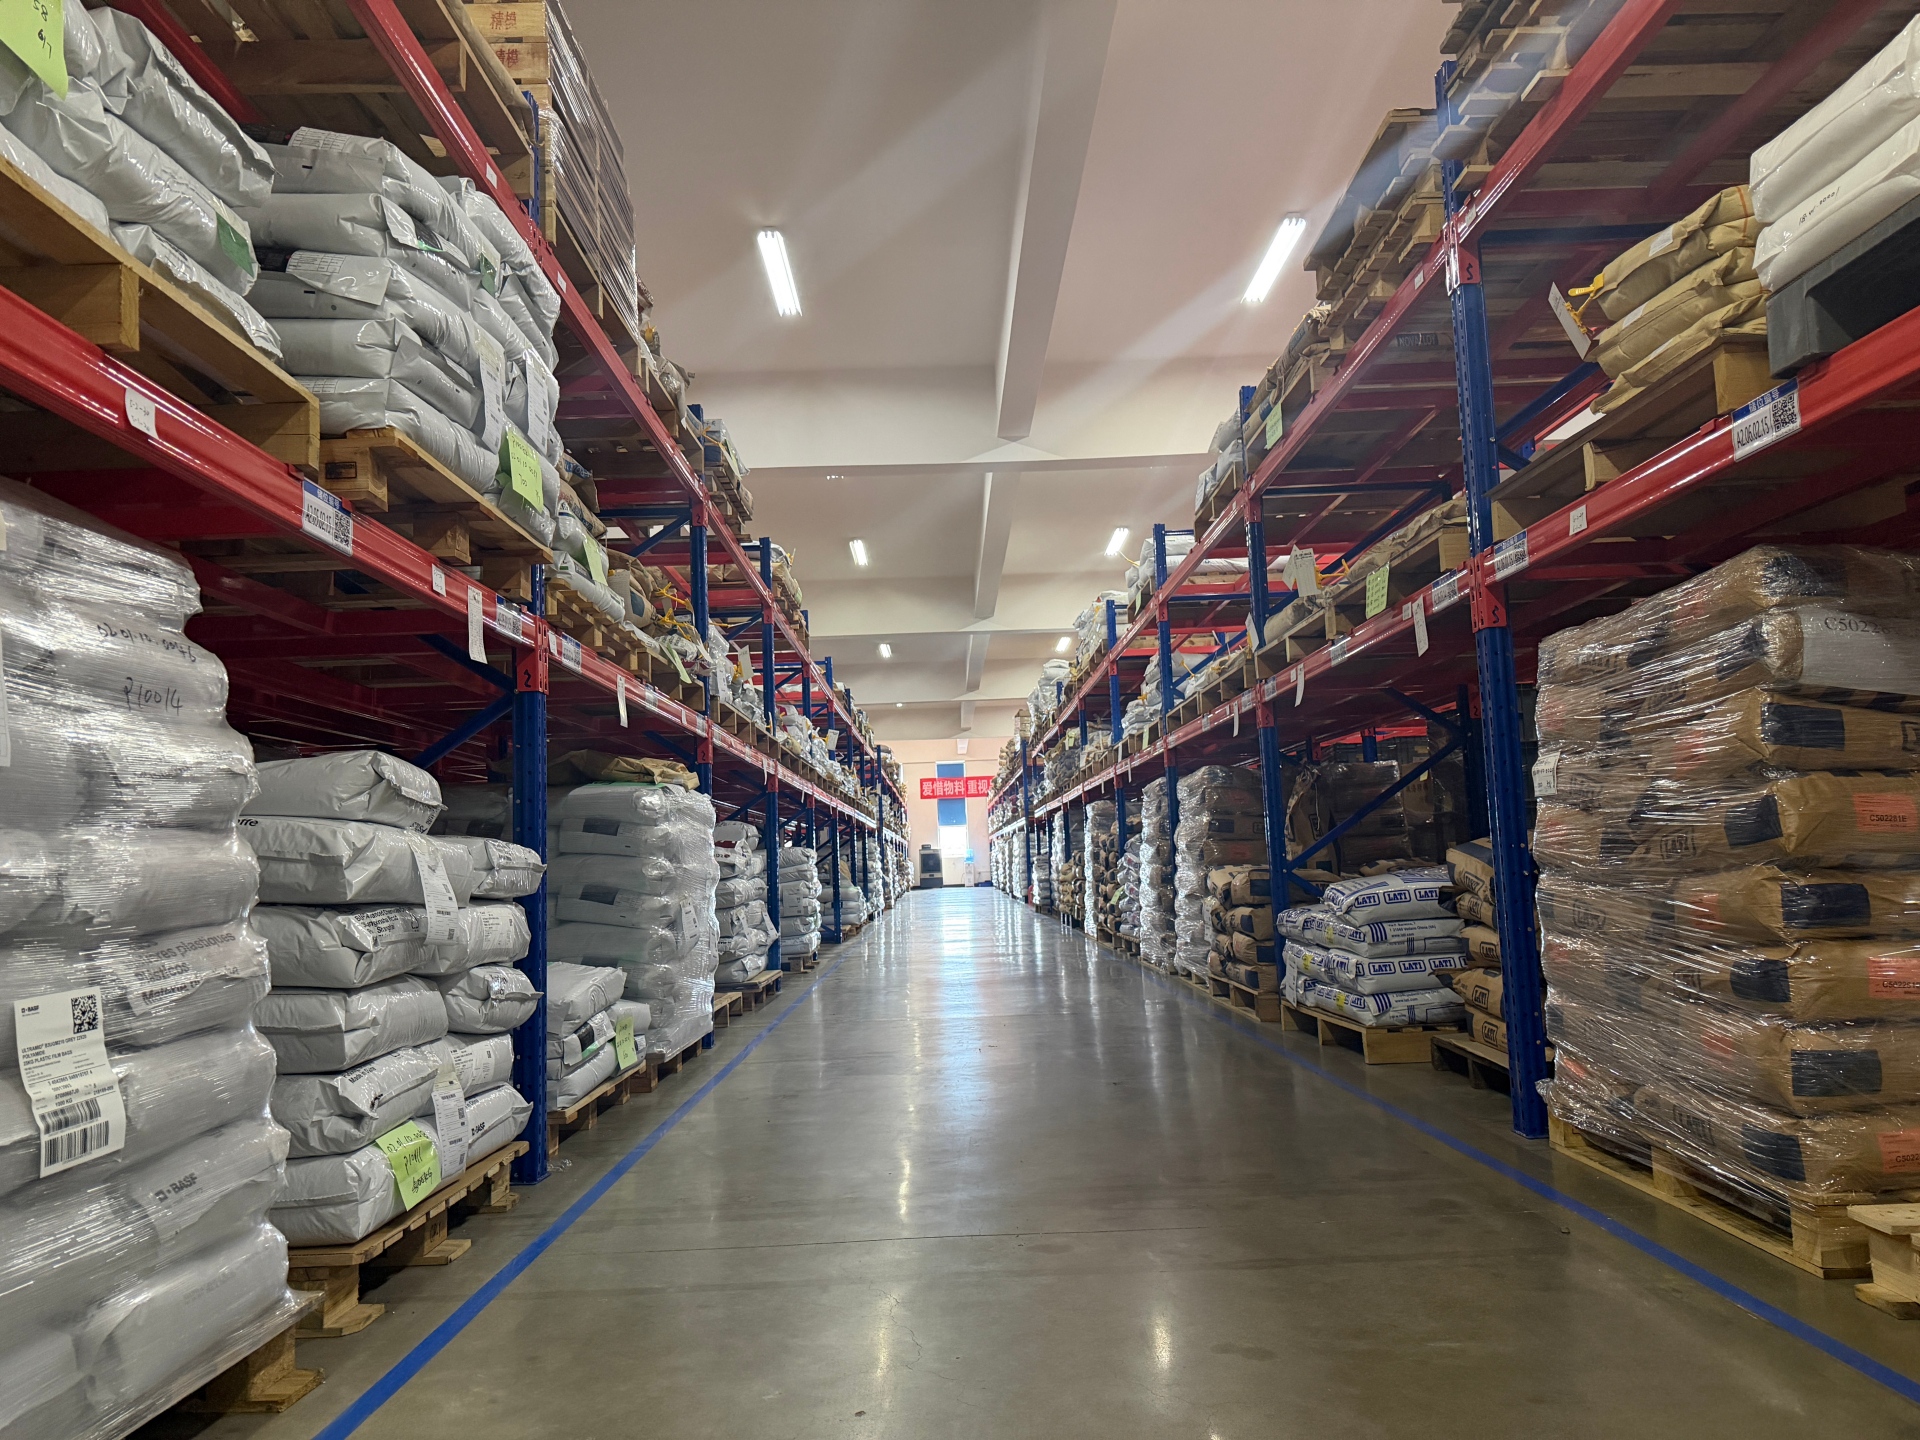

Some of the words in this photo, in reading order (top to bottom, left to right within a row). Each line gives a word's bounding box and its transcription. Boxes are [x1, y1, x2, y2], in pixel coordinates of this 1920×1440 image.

[922, 780, 965, 797] 爱惜物料
[1387, 891, 1408, 902] LATI
[1418, 889, 1439, 900] LATI
[176, 932, 236, 957] plastiques
[1372, 963, 1393, 973] LATI
[1402, 961, 1424, 971] LATI
[1432, 959, 1453, 969] LATI
[22, 1050, 45, 1060] POLYAMIDE
[34, 1054, 52, 1064] PLASTIC
[61, 1049, 73, 1057] BAGS
